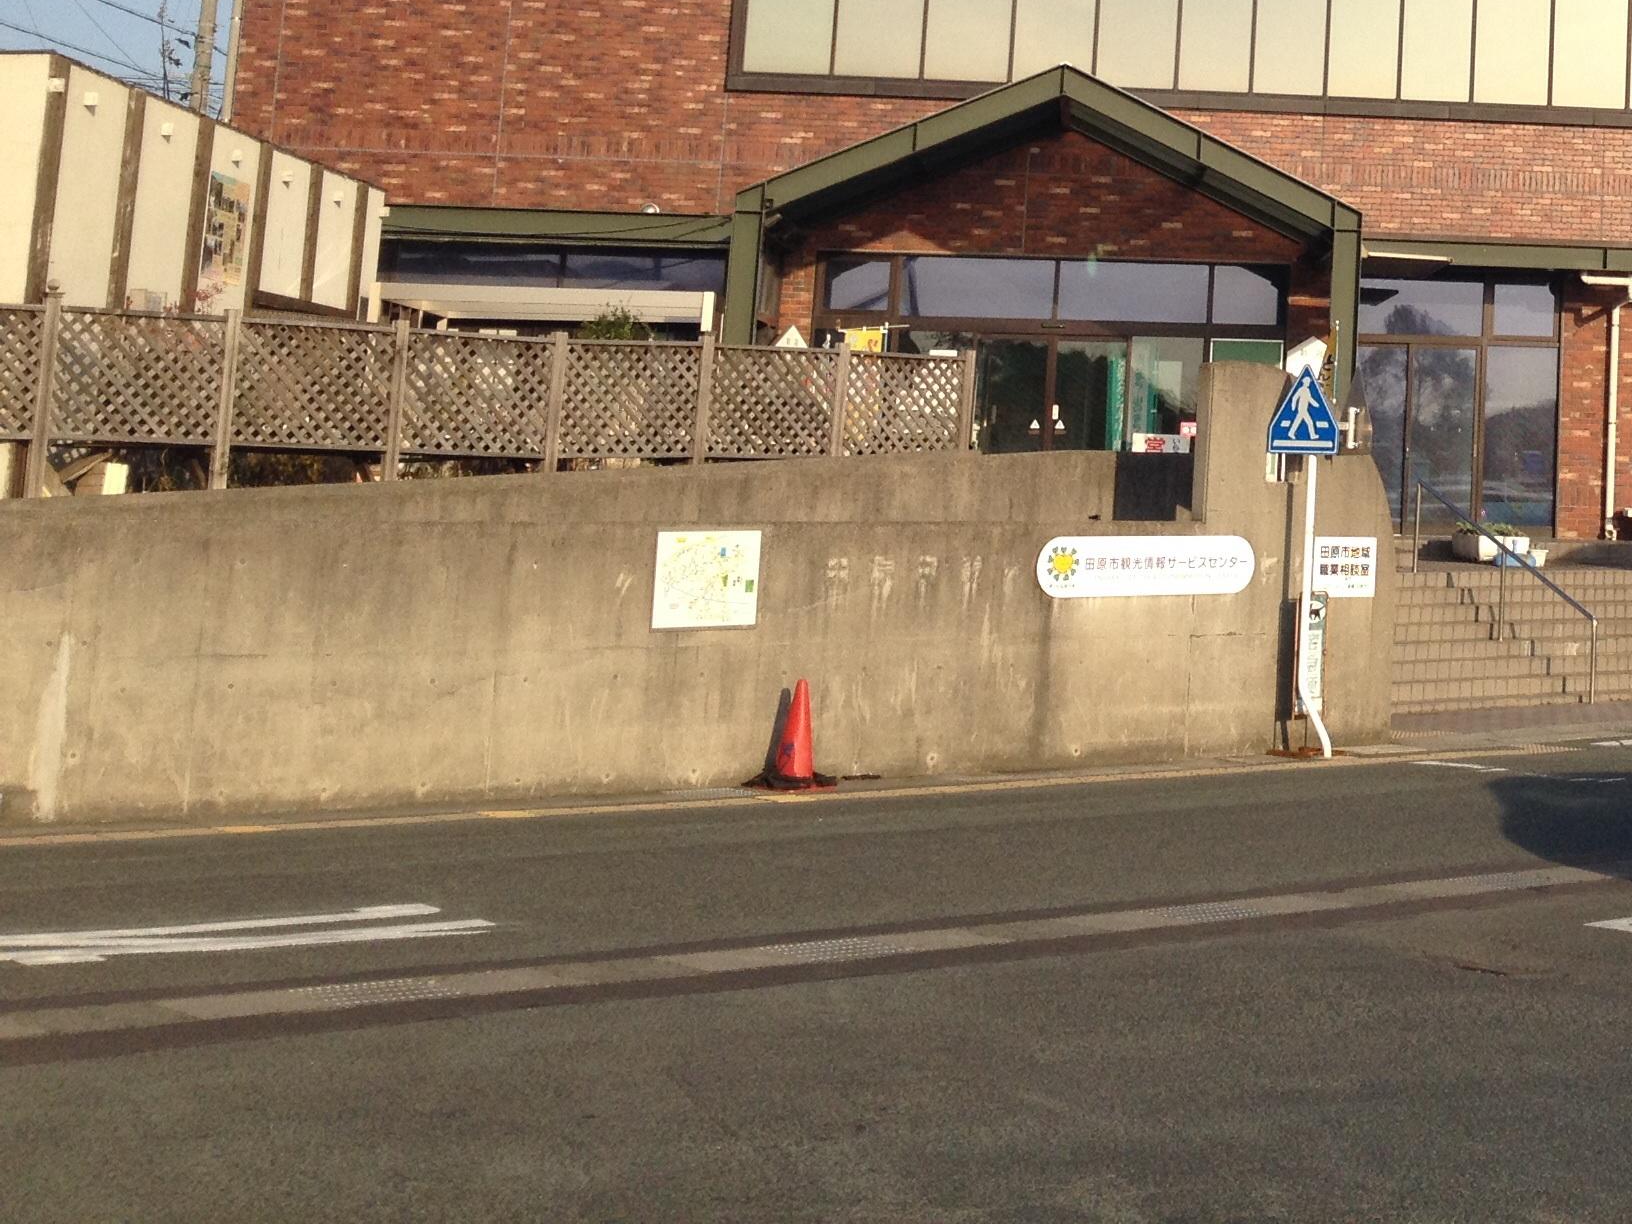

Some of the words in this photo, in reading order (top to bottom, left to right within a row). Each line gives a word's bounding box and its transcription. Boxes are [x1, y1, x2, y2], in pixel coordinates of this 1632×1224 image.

[1084, 555, 1249, 571] 田原市観光情報サービスセンター
